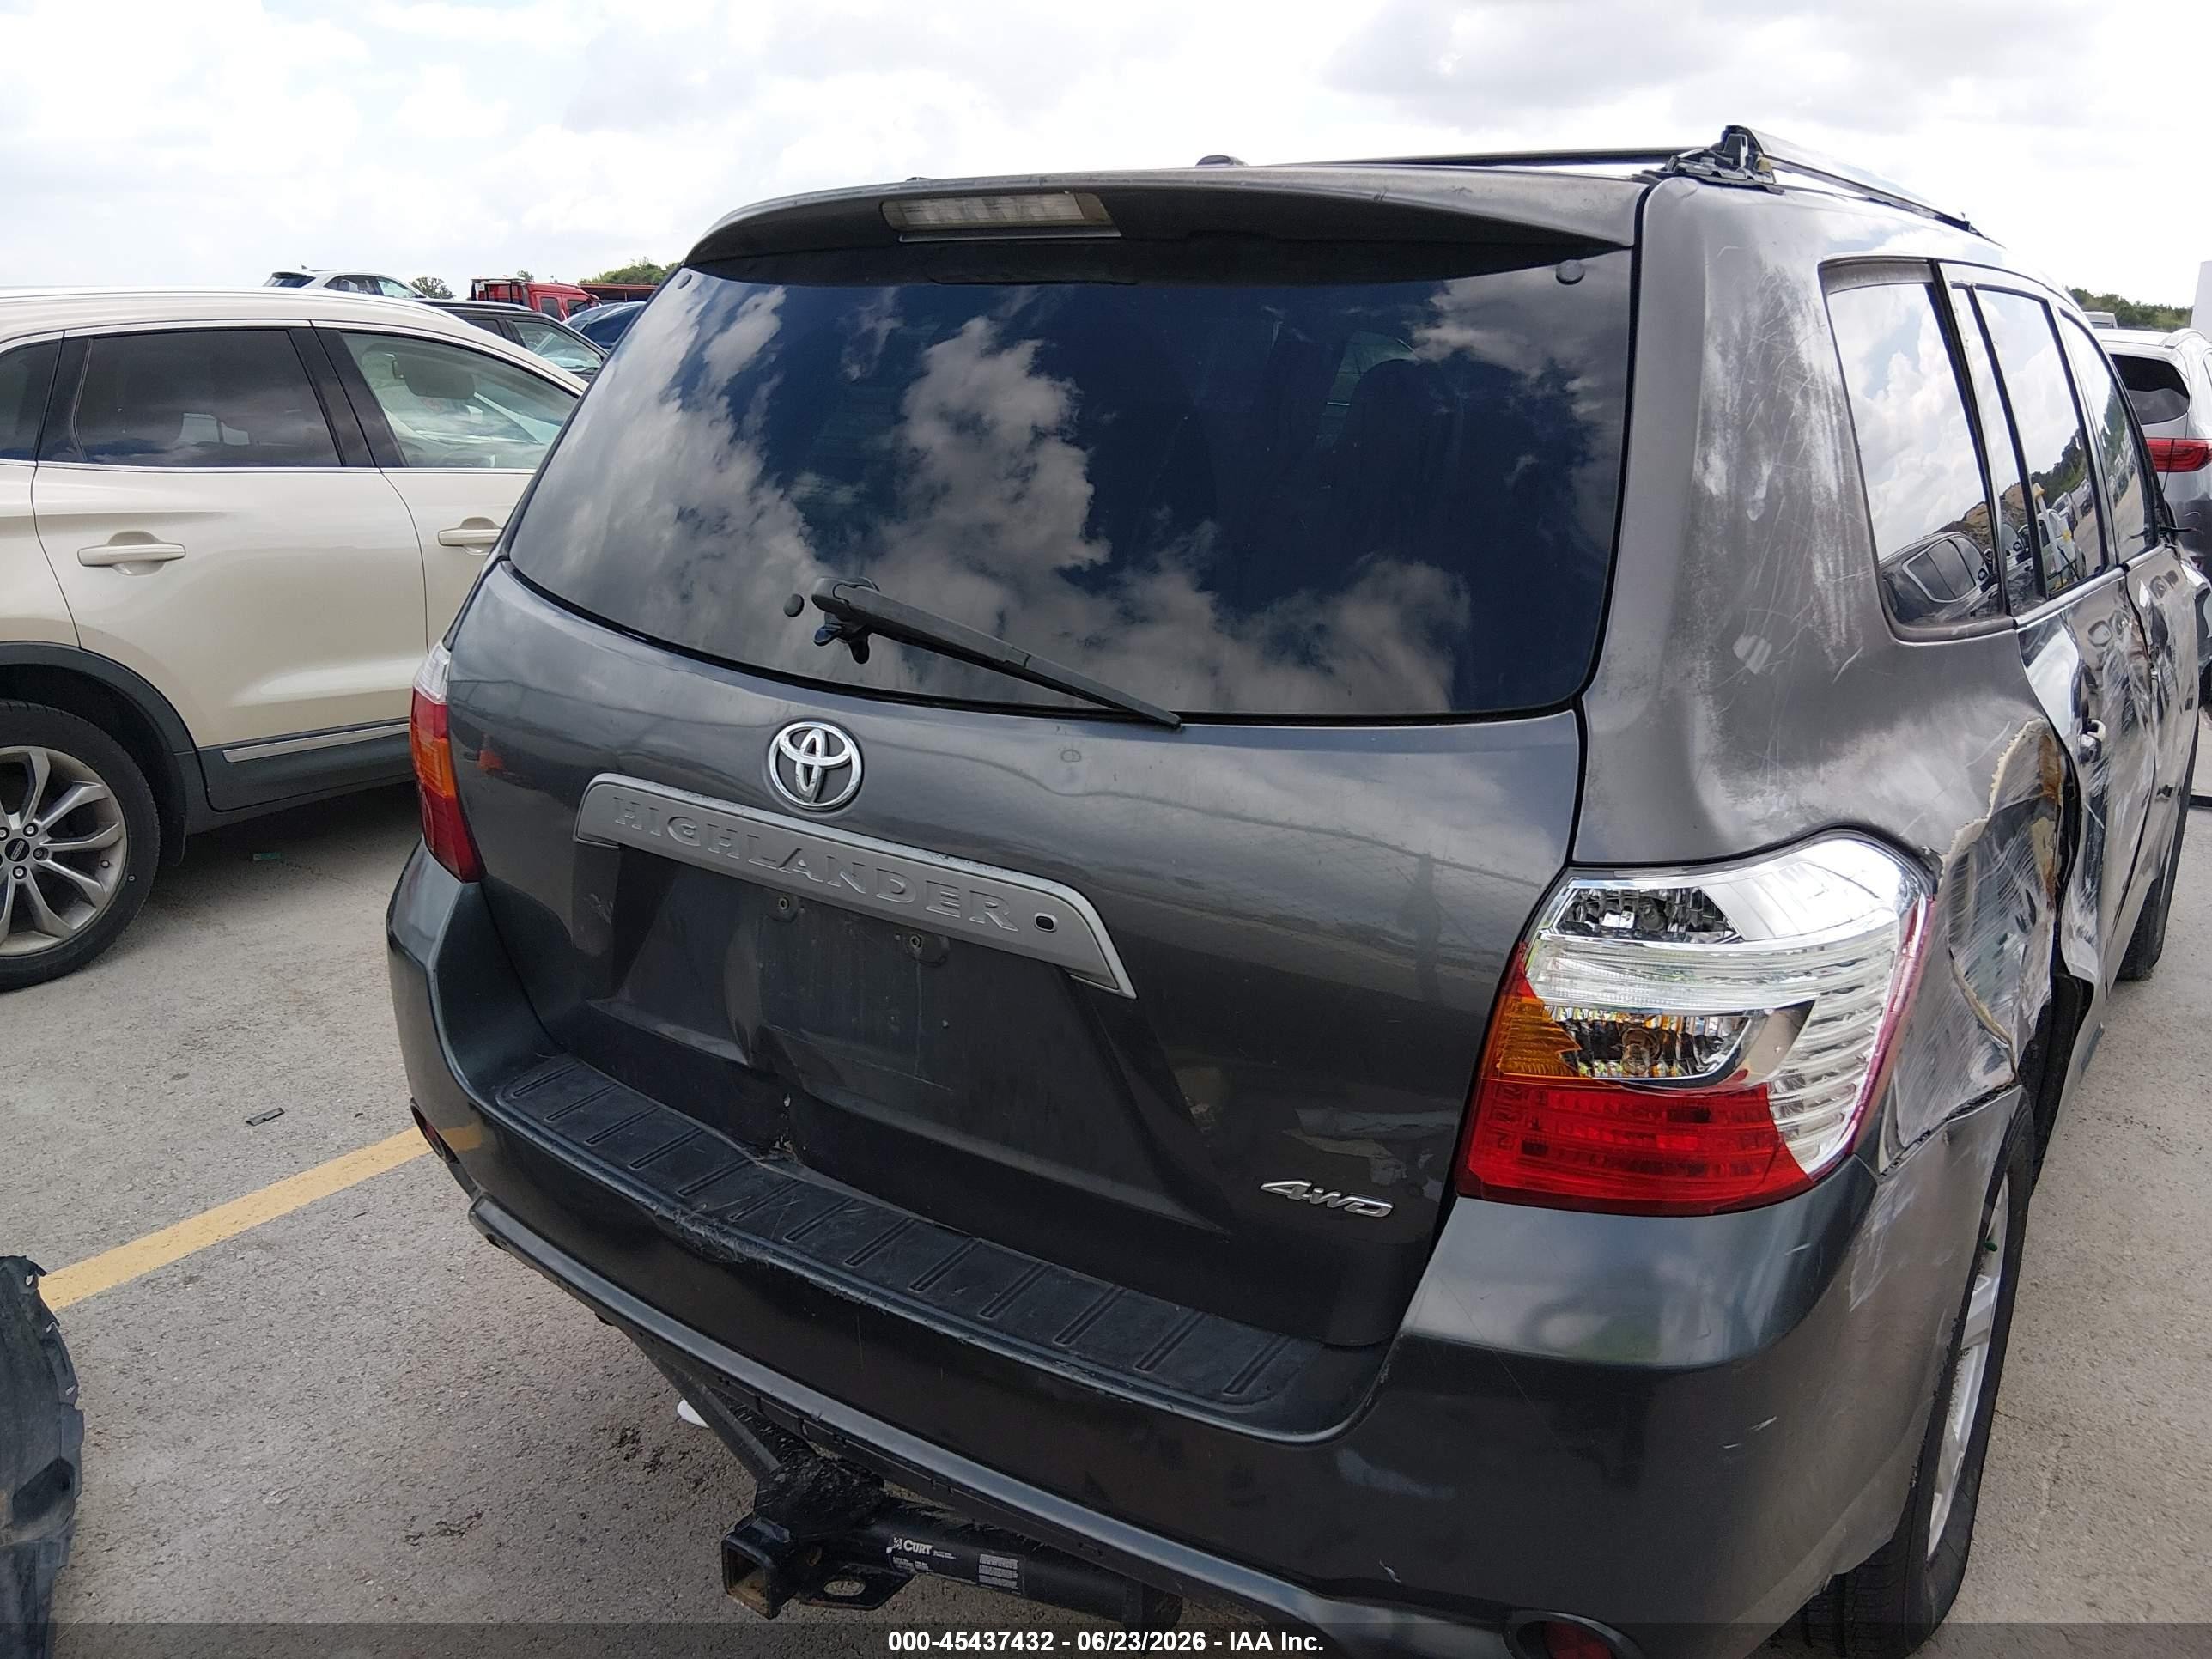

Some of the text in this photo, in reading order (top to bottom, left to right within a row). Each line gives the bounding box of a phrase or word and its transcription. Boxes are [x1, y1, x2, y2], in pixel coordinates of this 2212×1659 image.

[612, 796, 1019, 933] HIGHLANDER
[1260, 1179, 1395, 1218] 4WD
[902, 1539, 933, 1555] CURT
